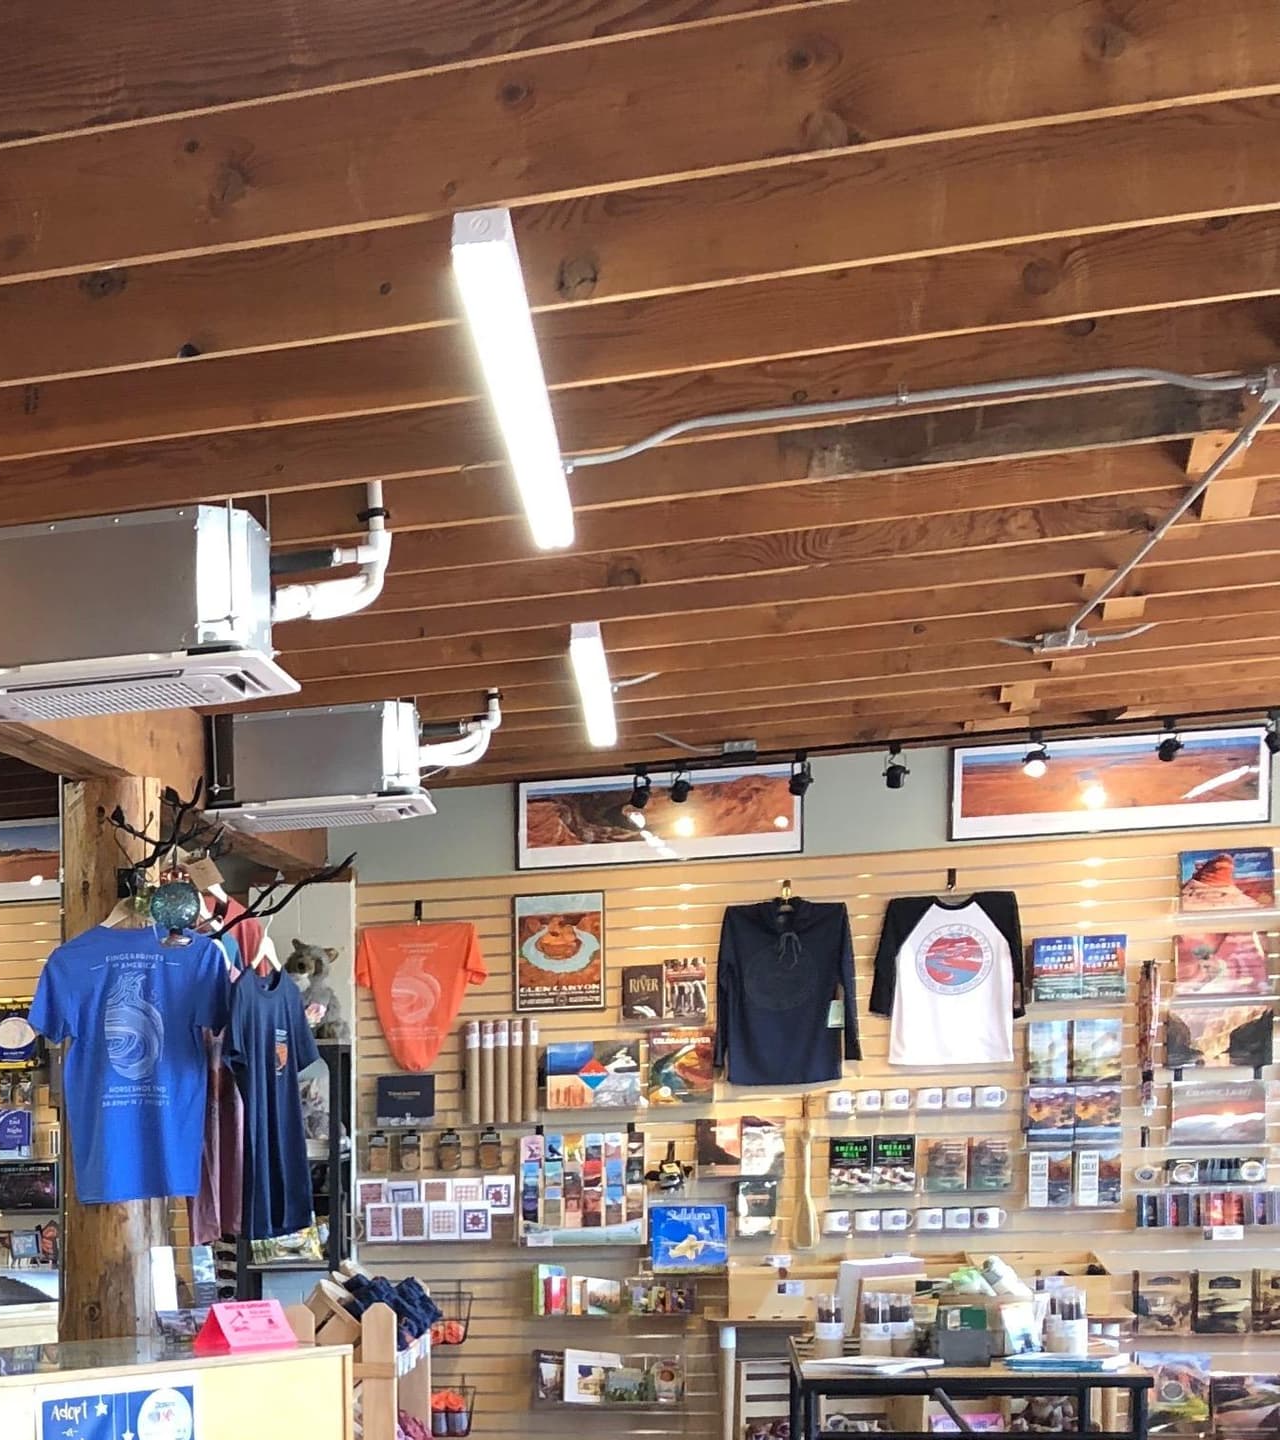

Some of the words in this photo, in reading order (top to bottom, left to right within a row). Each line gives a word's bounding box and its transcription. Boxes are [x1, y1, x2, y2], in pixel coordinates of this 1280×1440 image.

[553, 984, 600, 992] CANYON
[629, 977, 659, 993] RIVER
[878, 1143, 911, 1151] EMERALD
[667, 1207, 712, 1221] Stellaluna
[50, 1400, 89, 1424] Adopt
